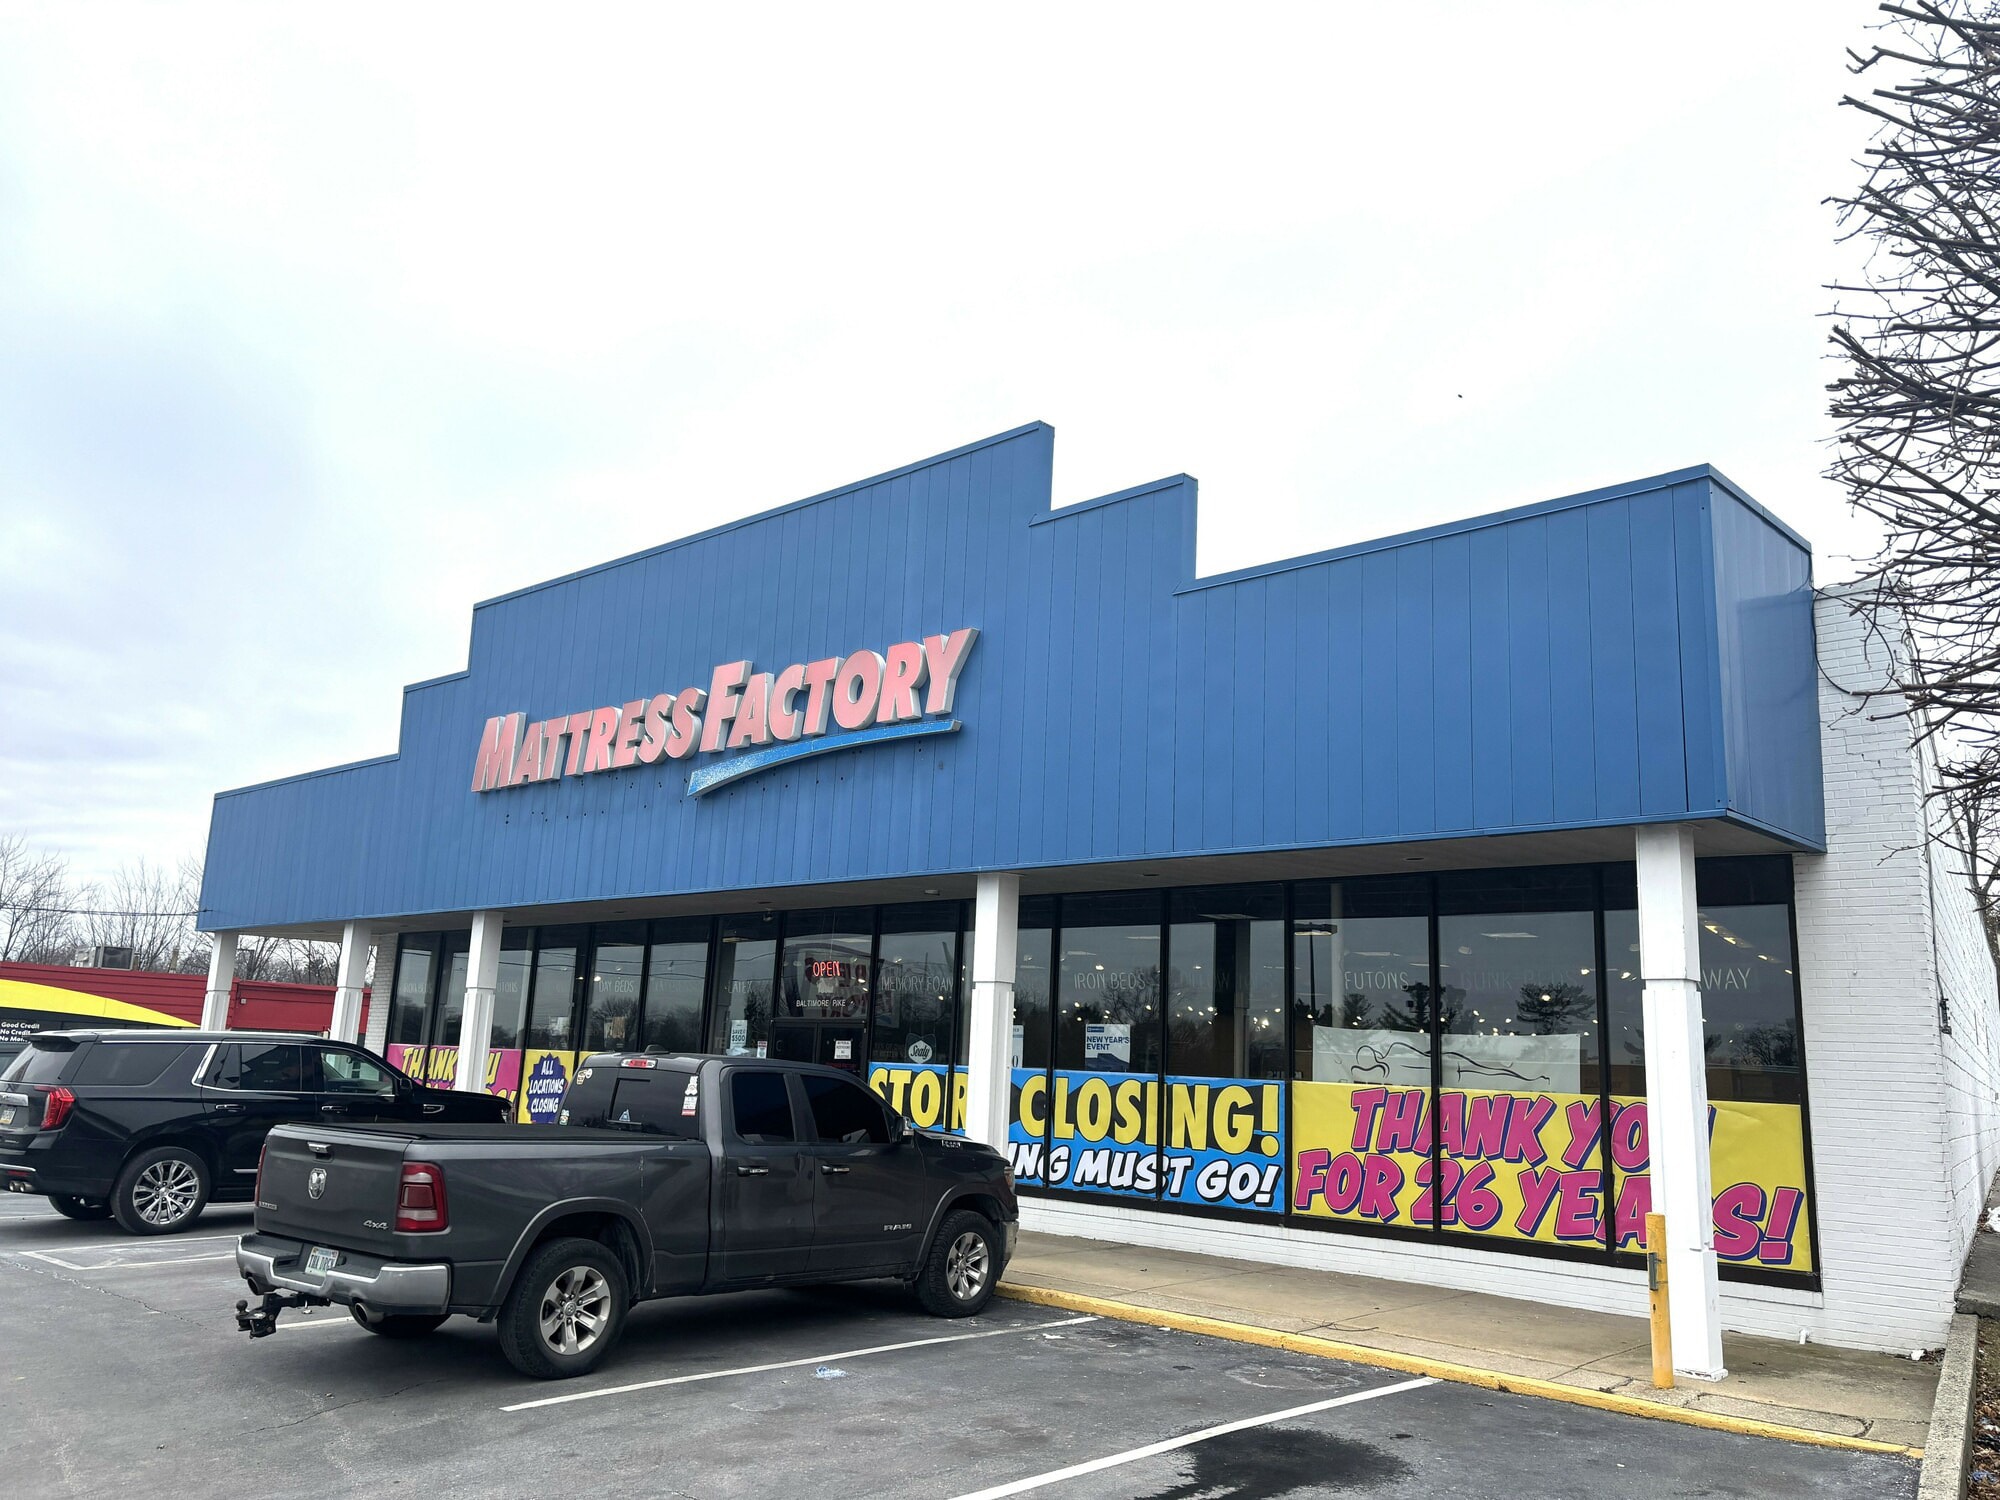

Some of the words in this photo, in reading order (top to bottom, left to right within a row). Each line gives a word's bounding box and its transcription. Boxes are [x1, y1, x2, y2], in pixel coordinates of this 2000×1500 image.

[812, 960, 841, 977] OPEN
[598, 980, 613, 993] DAY
[614, 980, 634, 993] BEDS
[728, 980, 754, 994] LATEX
[881, 975, 925, 993] MEMORY
[1074, 972, 1106, 990] IRON
[1111, 972, 1146, 990] BEDS
[1344, 970, 1409, 991] FUTONS
[796, 999, 829, 1008] BALTIMORE
[1, 1021, 19, 1029] Good
[20, 1022, 40, 1030] Credit
[731, 1034, 746, 1042] $500
[1086, 1036, 1104, 1044] NEW
[1105, 1036, 1130, 1045] YEAR'S
[910, 1044, 930, 1060] Sealy
[1086, 1043, 1110, 1051] EVENT
[401, 1046, 459, 1082] THANK
[541, 1060, 554, 1075] ALL
[528, 1078, 564, 1095] LOCATIONS
[531, 1097, 559, 1114] CLOSING
[869, 1067, 968, 1130] STOR
[1019, 1074, 1280, 1157] CLOSING!
[1351, 1085, 1556, 1168] THANK
[1560, 1098, 1717, 1173] YO
[1073, 1147, 1193, 1194] MUST
[1195, 1160, 1282, 1204] GO!
[1294, 1148, 1405, 1223] FOR
[1409, 1156, 1504, 1231] 26
[1513, 1165, 1804, 1265] YEAS!
[883, 1223, 912, 1232] RAM
